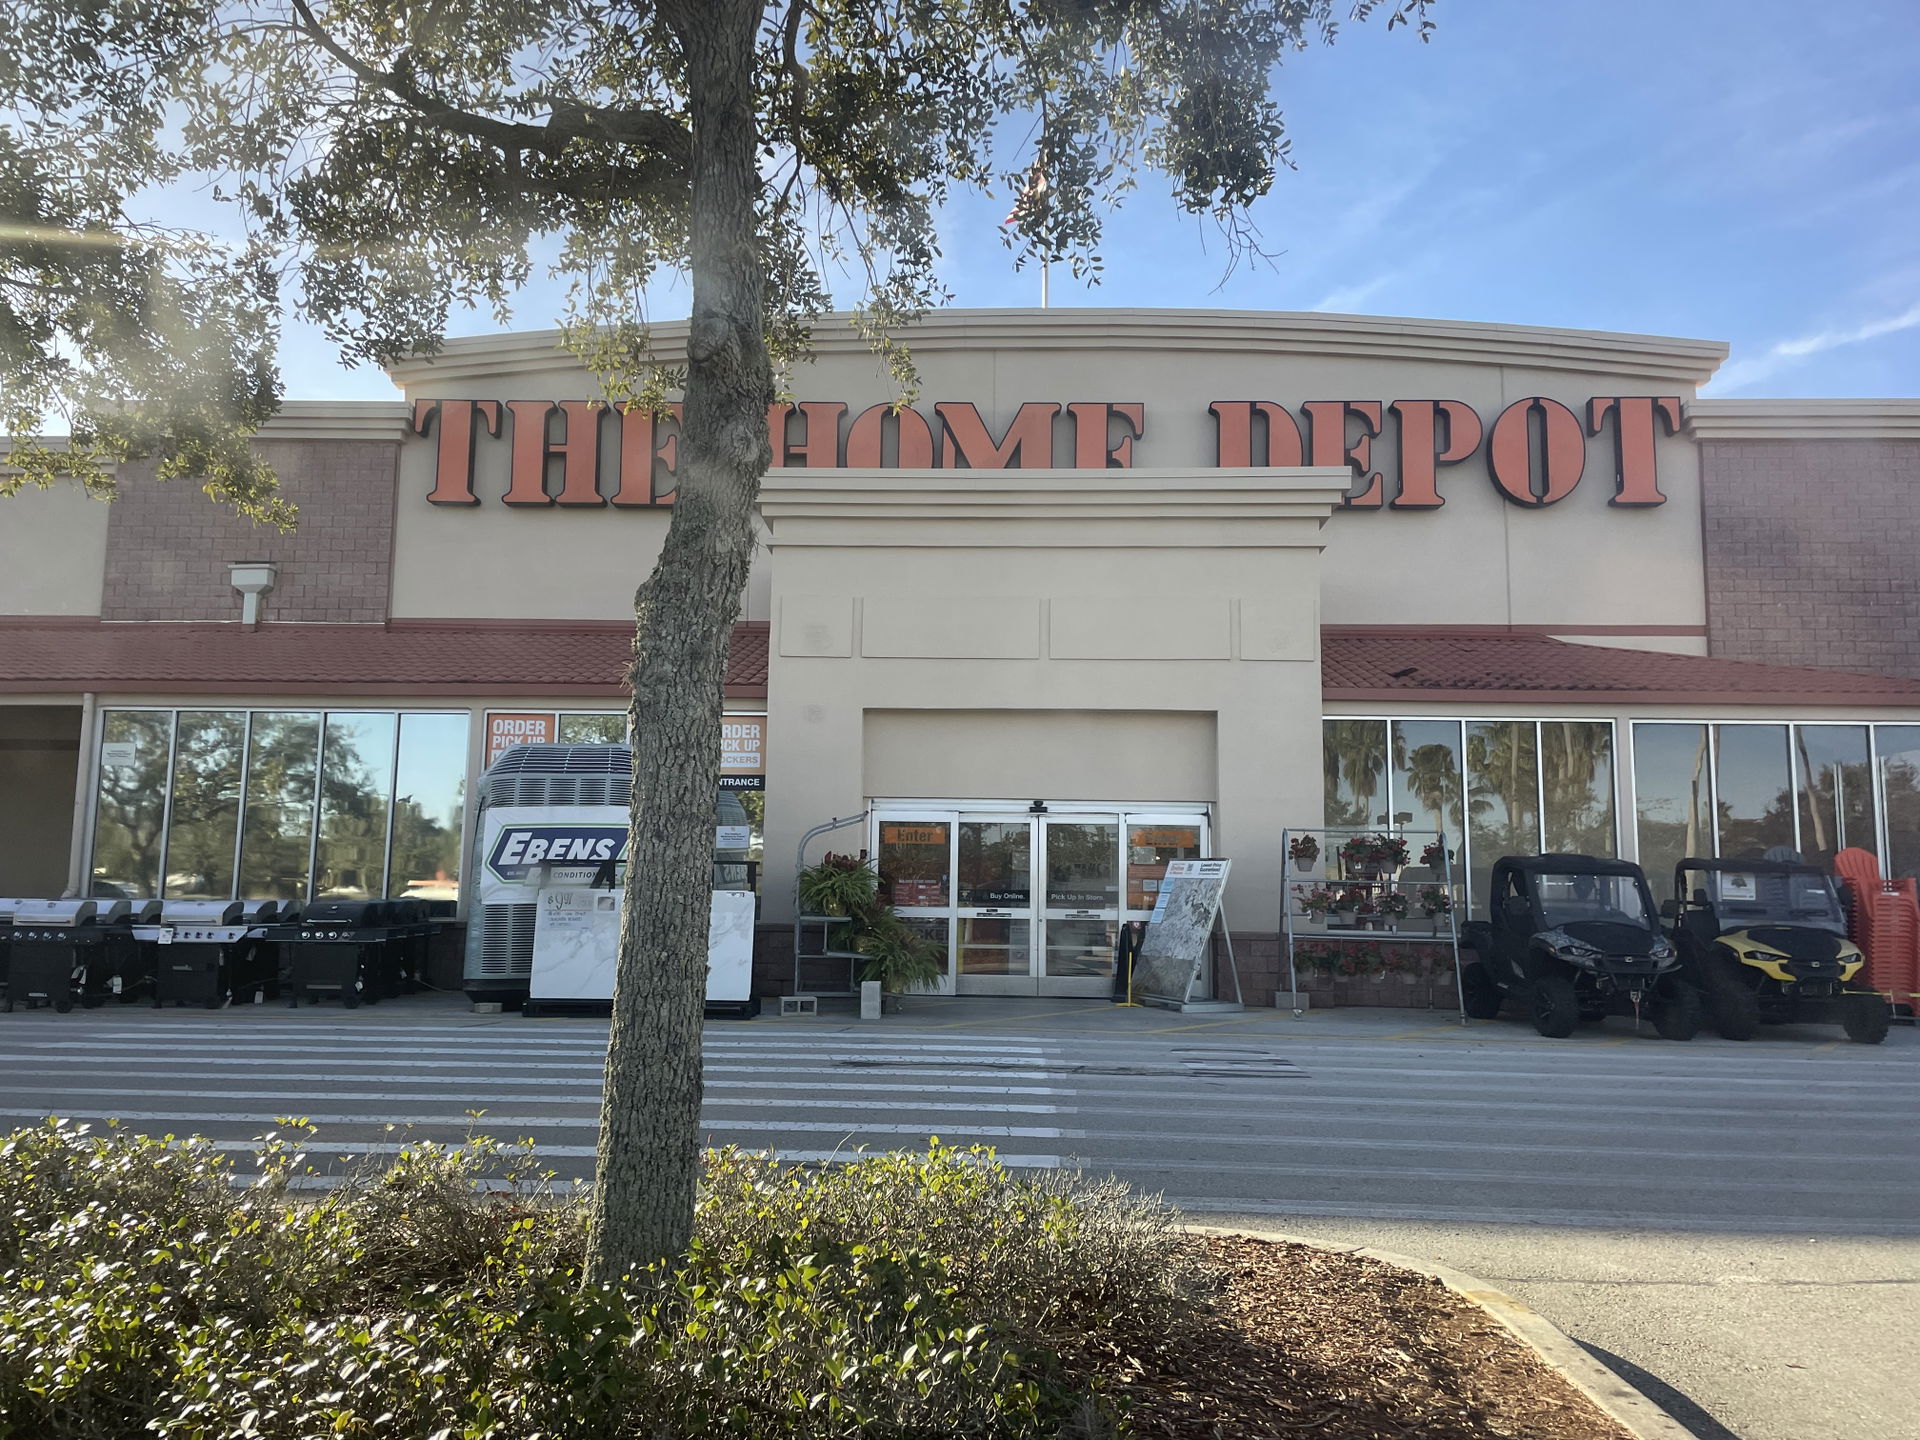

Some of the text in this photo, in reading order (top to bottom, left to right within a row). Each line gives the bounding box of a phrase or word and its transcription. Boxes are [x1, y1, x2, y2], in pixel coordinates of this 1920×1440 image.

[414, 398, 682, 507] THE
[1208, 396, 1682, 511] DEPOT
[493, 720, 546, 735] ORDER
[721, 725, 760, 738] RDER
[492, 736, 523, 748] PICK
[721, 740, 760, 751] ICK UP
[721, 756, 759, 764] OCKERS
[719, 778, 760, 786] NTRANCE
[897, 829, 933, 842] Enter
[498, 832, 616, 866] EBENS
